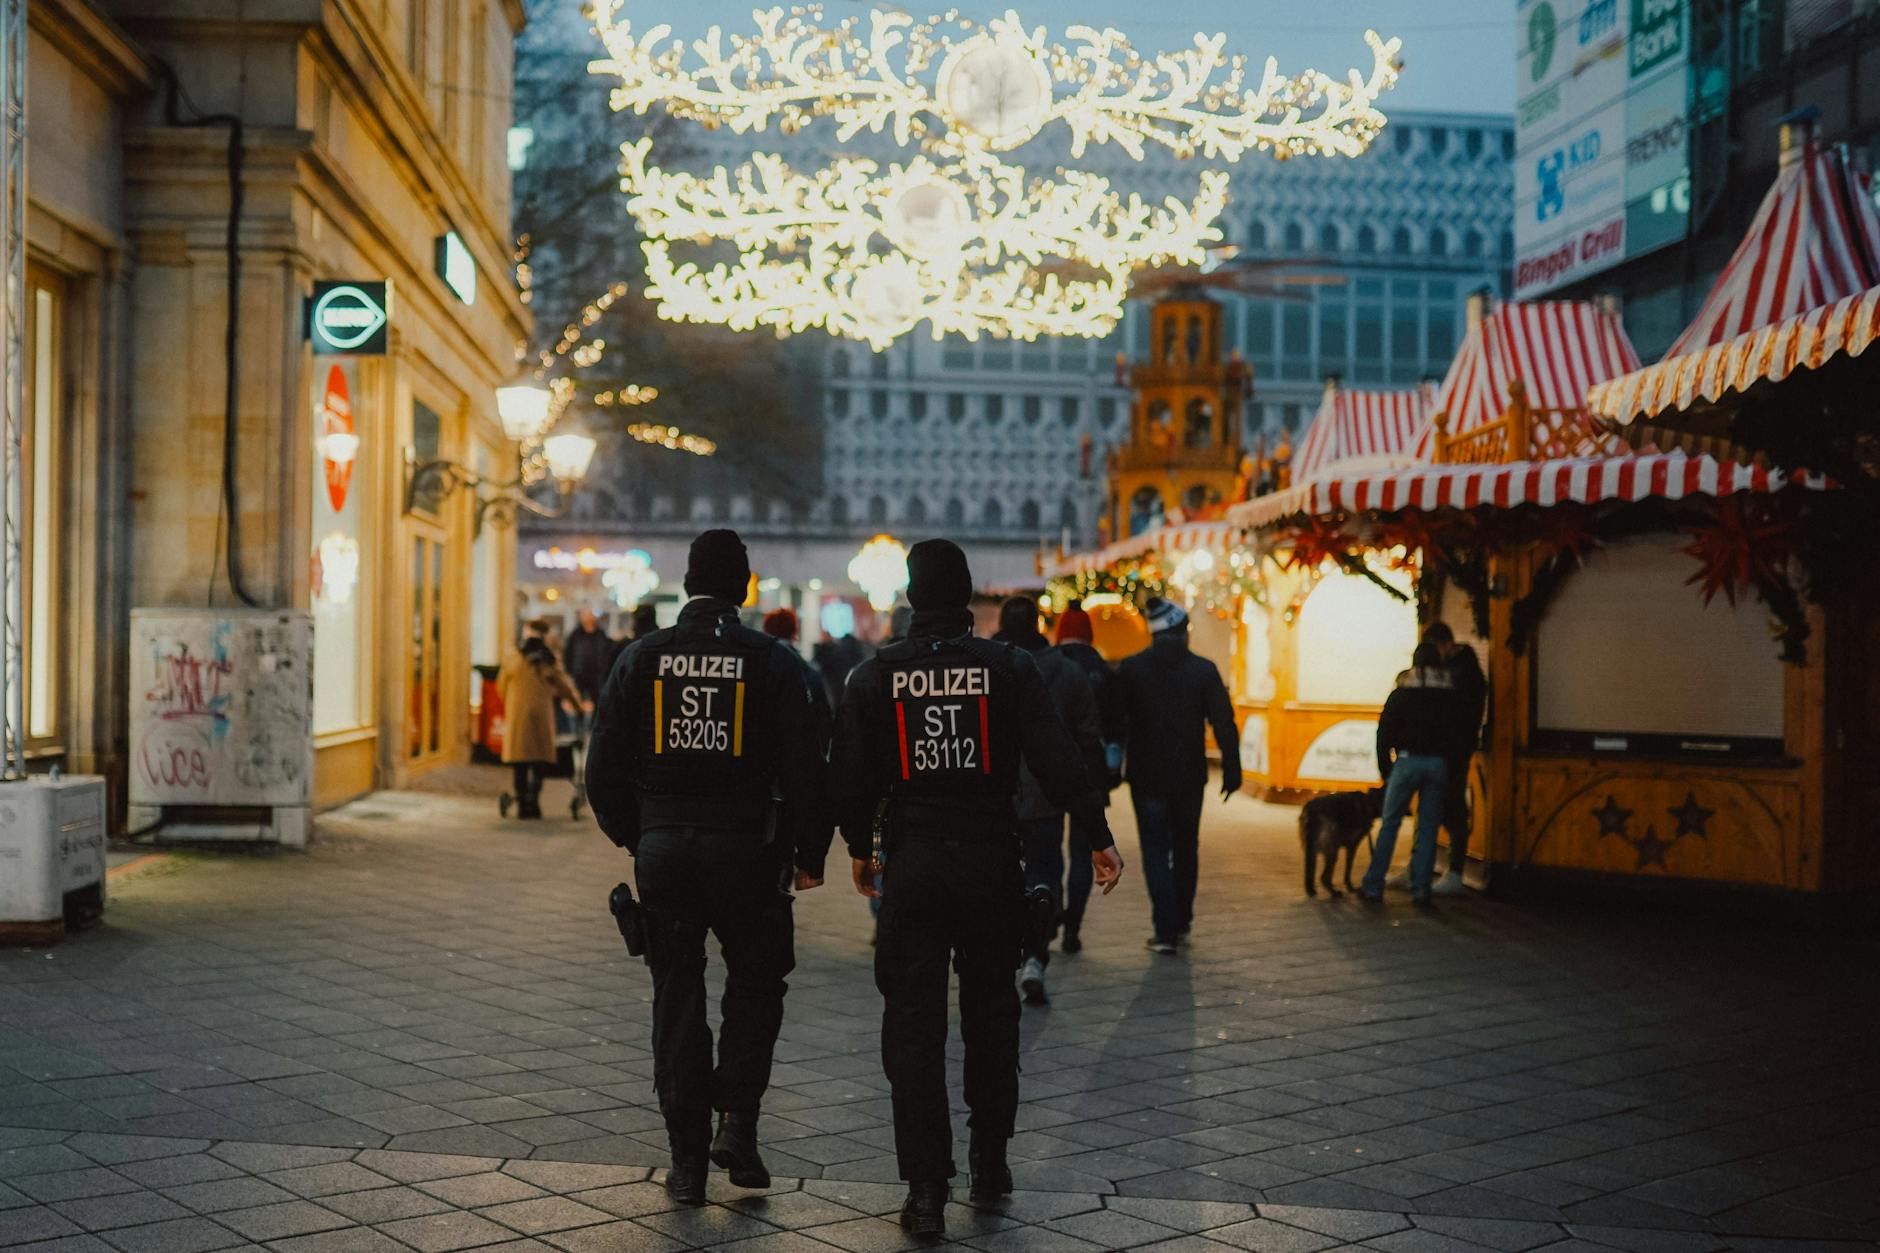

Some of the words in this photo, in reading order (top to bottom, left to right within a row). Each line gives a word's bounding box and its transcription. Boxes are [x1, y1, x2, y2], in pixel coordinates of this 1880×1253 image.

[658, 655, 743, 679] POLIZEI
[893, 668, 990, 698] POLIZEI
[680, 686, 718, 718] ST
[669, 718, 728, 751] 53205
[924, 705, 962, 737] ST
[914, 737, 976, 770] 53112
